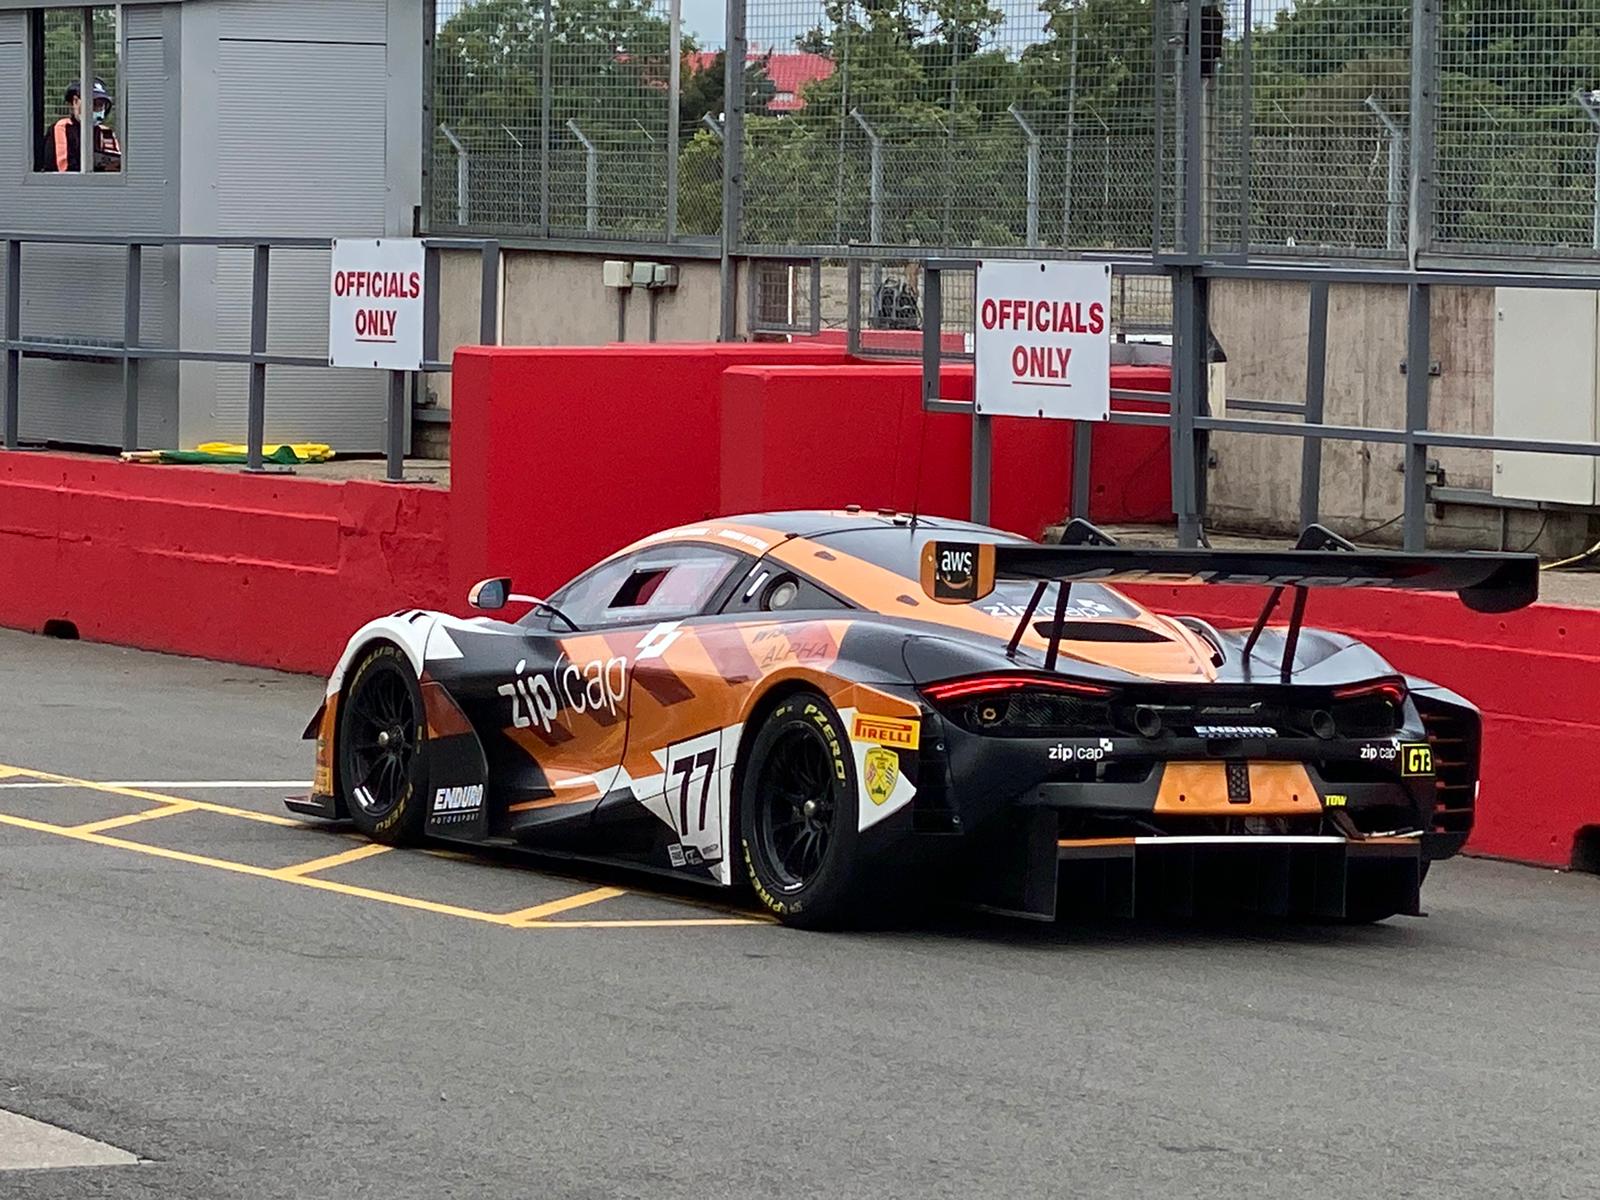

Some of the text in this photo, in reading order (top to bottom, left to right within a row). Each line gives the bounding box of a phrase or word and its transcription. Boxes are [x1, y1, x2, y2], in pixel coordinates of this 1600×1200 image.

[334, 270, 420, 299] OFFICIALS
[355, 308, 397, 336] ONLY
[981, 298, 1104, 335] OFFICIALS
[1012, 345, 1072, 379] ONLY
[941, 550, 972, 574] aws
[761, 642, 829, 664] ALPHA
[854, 718, 913, 744] PIRELLI
[1193, 725, 1278, 735] ENDURO
[1408, 748, 1432, 773] GT3
[433, 783, 484, 811] ENDURO
[672, 747, 718, 837] 77
[1324, 795, 1348, 807] TOW
